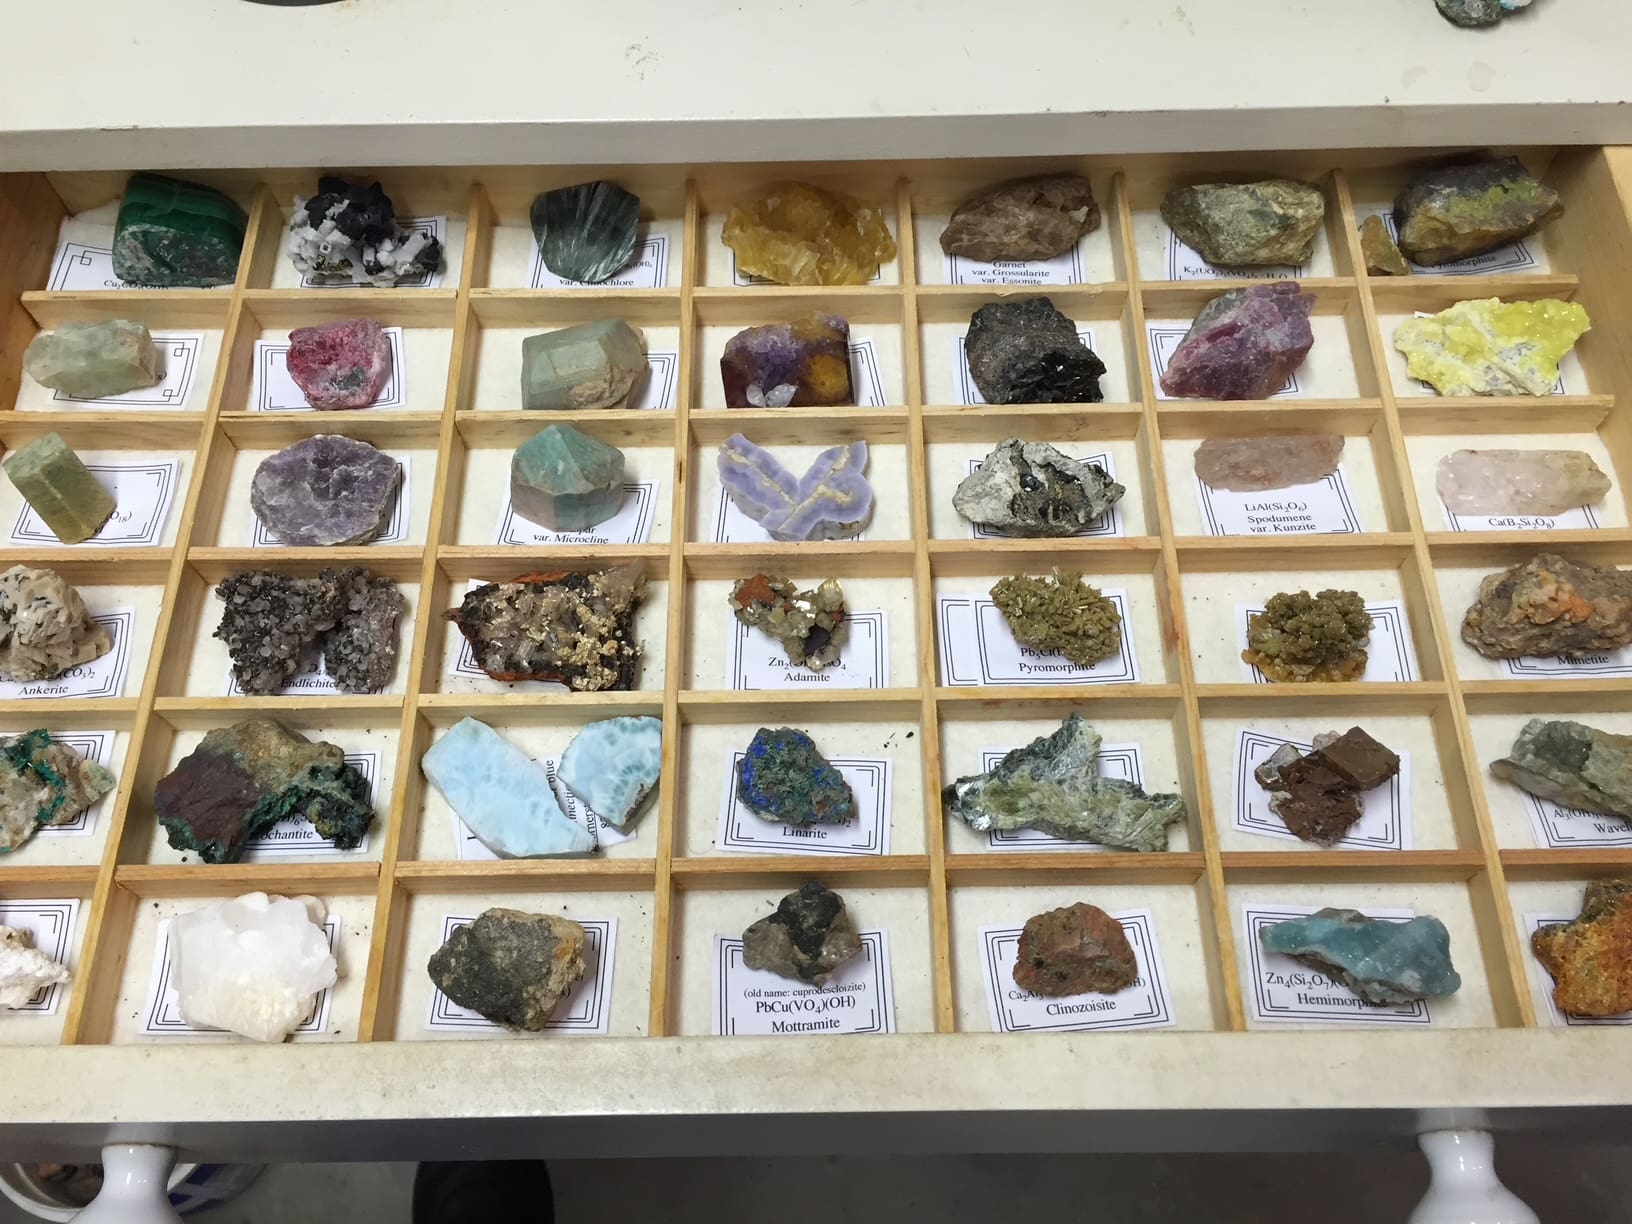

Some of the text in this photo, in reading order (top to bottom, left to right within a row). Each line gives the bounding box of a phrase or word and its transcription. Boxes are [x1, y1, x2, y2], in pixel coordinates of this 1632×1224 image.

[971, 269, 1050, 278] var. Grossularite
[1247, 514, 1312, 525] Spodumene
[1274, 523, 1317, 532] Kunzite
[533, 533, 608, 544] var. Microcline
[1019, 662, 1096, 673] Pyromorphite
[783, 672, 830, 682] Adamite
[18, 684, 69, 696] Ankerite
[783, 826, 828, 839] Linarite
[744, 987, 764, 999] (old
[766, 987, 790, 998] name:
[1046, 1000, 1117, 1016] Clinozoisite
[771, 1018, 841, 1033] Mottramite
